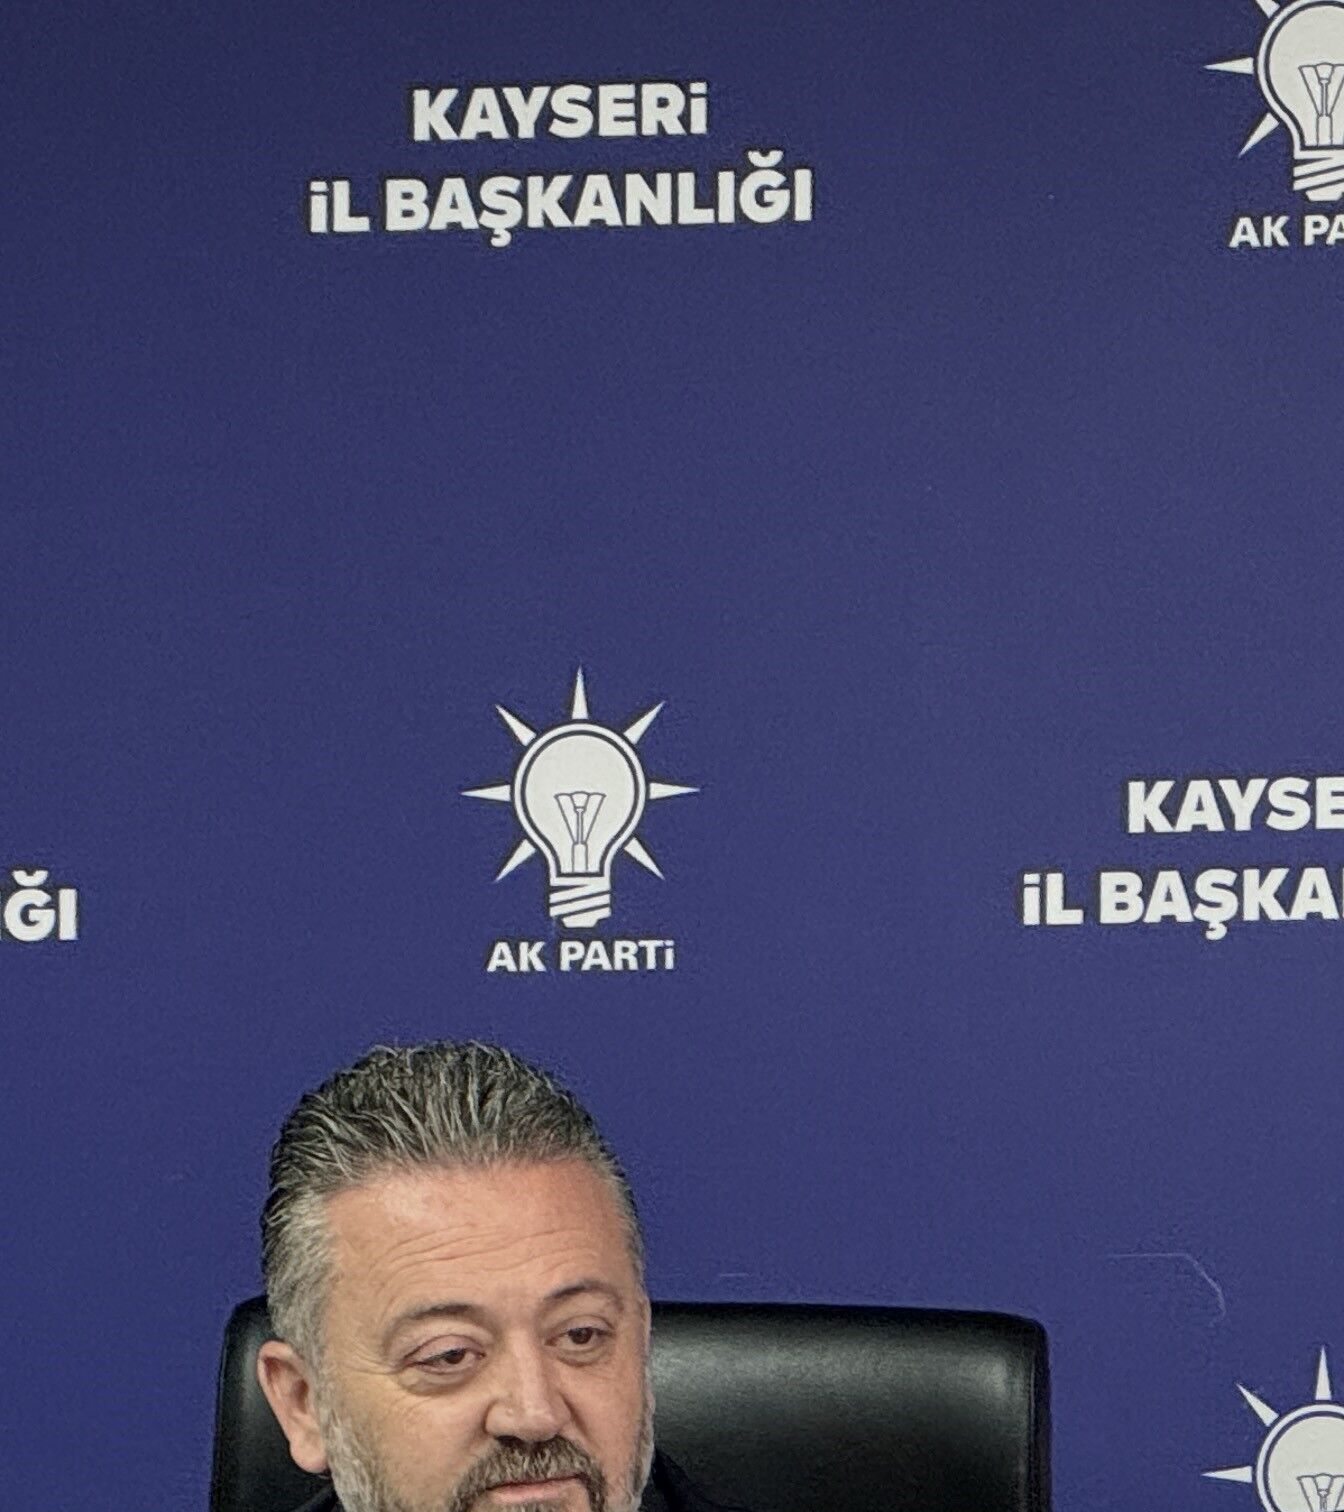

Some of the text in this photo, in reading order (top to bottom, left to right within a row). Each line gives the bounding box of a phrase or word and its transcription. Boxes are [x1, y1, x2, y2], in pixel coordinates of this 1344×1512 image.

[384, 150, 814, 249] BAŞKANLIĞI
[1228, 215, 1291, 249] AK
[485, 940, 548, 974] AK
